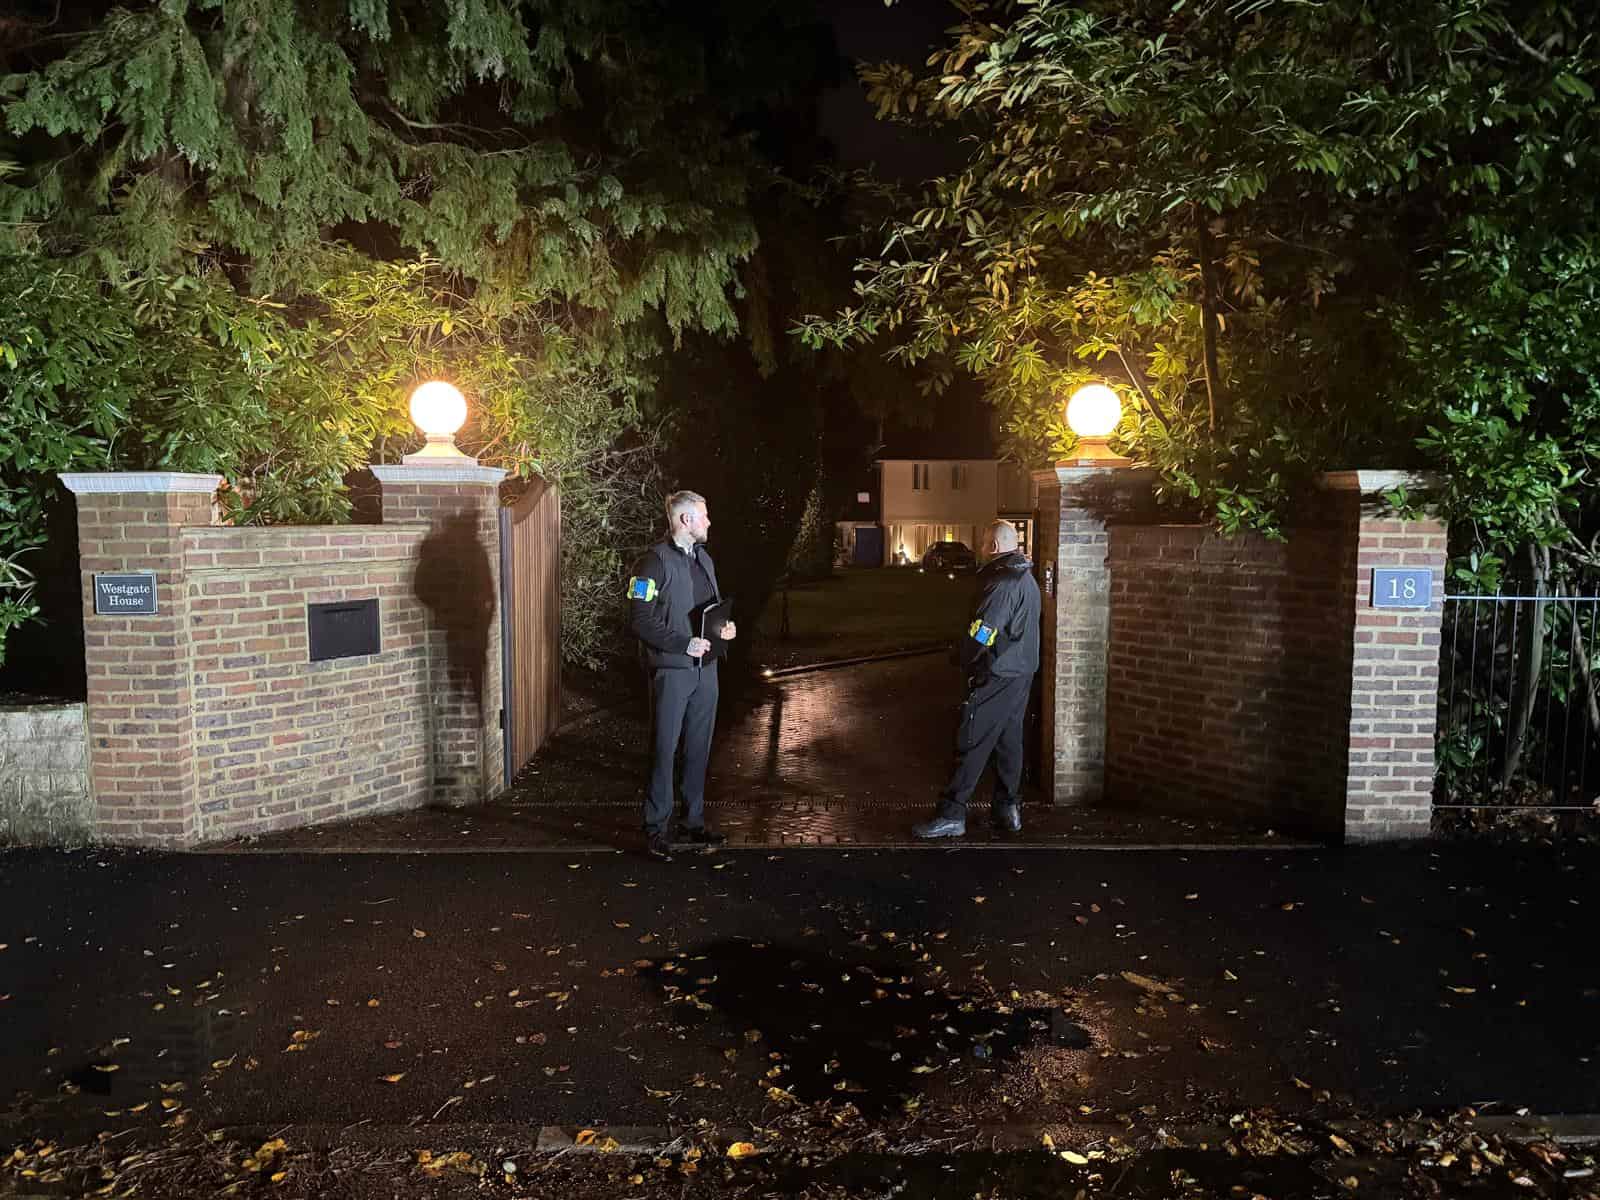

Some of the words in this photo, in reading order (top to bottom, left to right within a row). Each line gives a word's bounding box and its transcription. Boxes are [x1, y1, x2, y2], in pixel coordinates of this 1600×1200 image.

[100, 583, 150, 596] Westgate
[1388, 577, 1416, 599] 18
[109, 595, 144, 606] House
